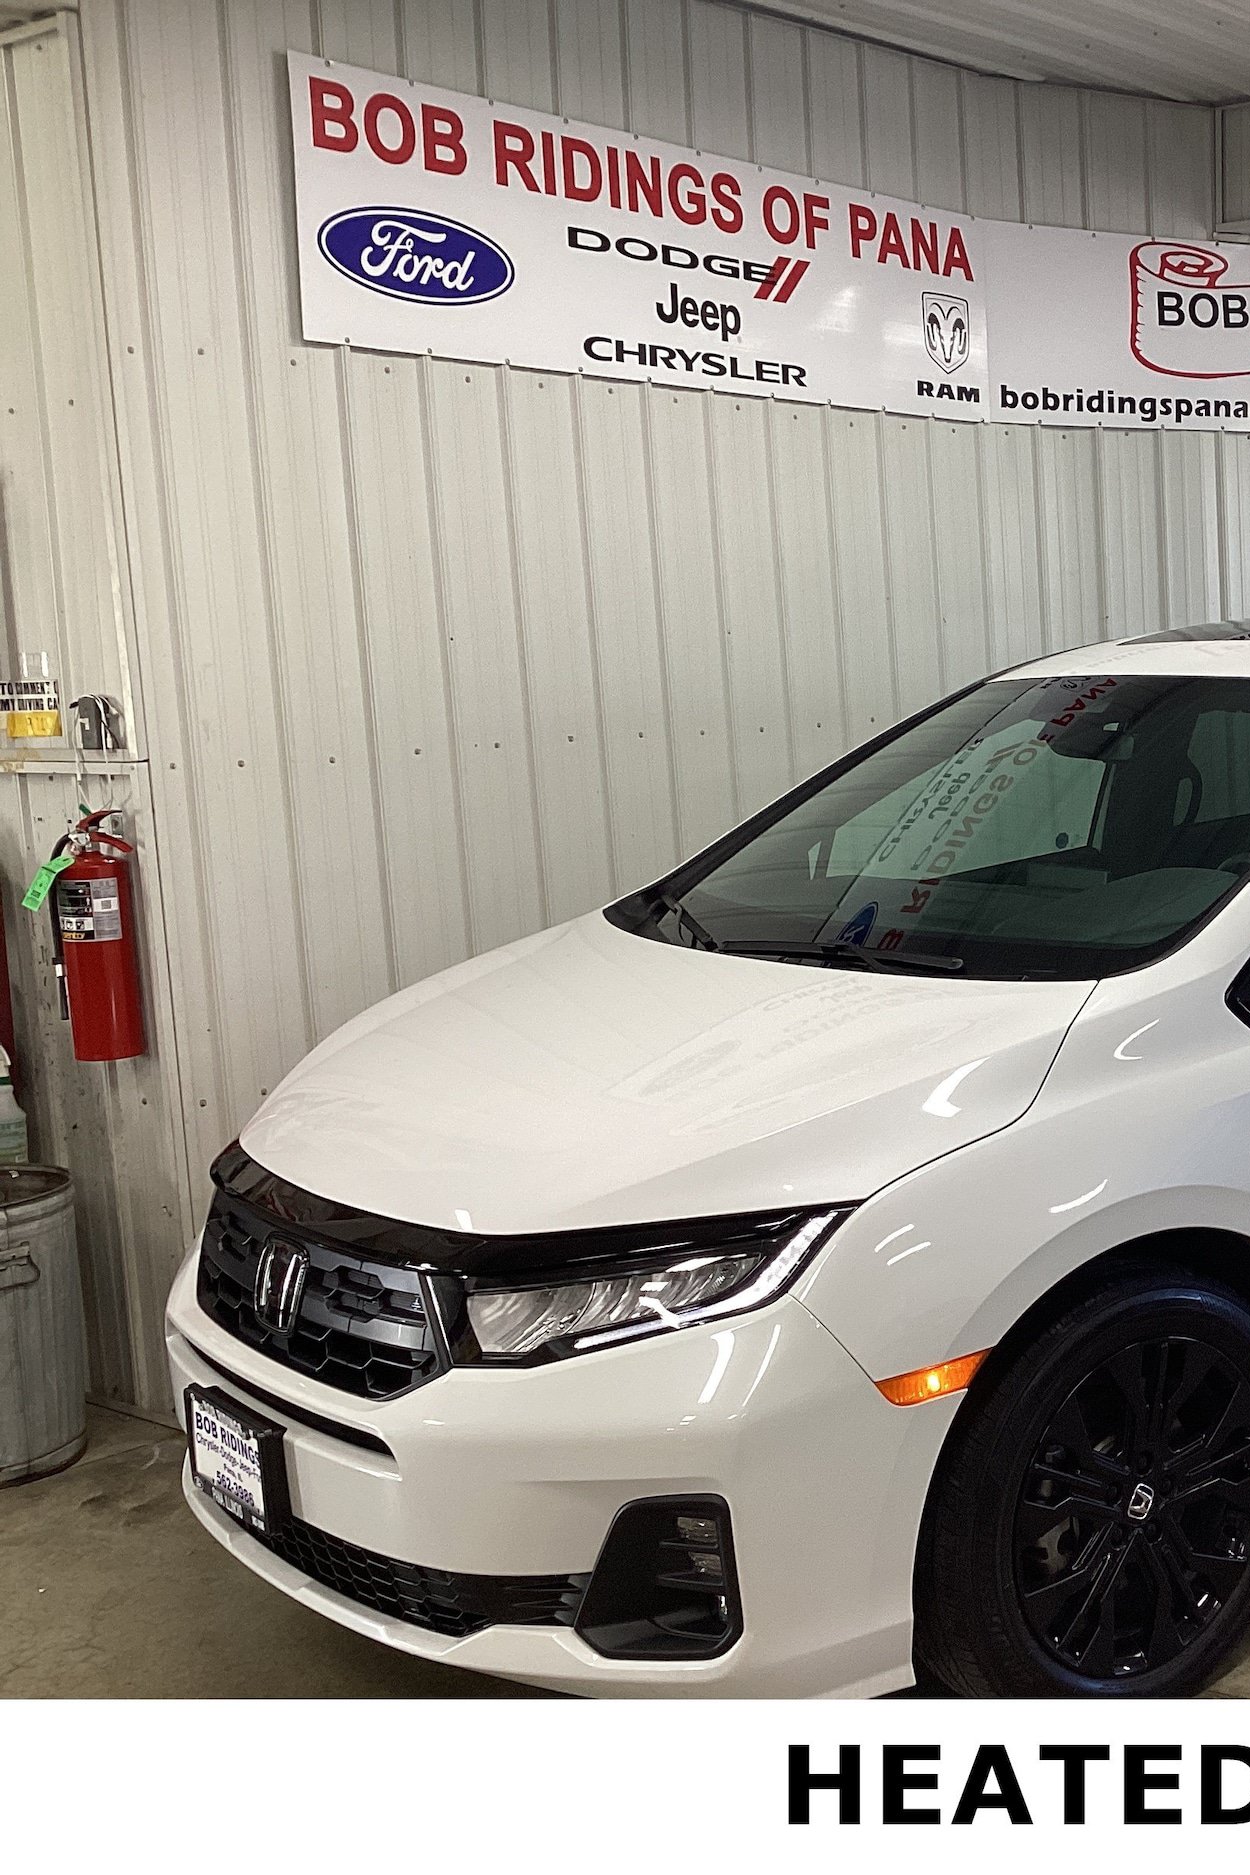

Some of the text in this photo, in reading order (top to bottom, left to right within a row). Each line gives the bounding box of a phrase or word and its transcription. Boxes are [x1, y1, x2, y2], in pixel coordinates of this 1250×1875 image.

[308, 76, 976, 281] BOB RIDINGS OF PANA
[360, 221, 476, 292] Ford
[567, 226, 778, 285] DODGE
[655, 283, 743, 342] Jeep
[1156, 290, 1249, 329] BOB
[582, 336, 809, 388] CHRYSLER
[916, 380, 981, 404] RAM
[195, 1411, 218, 1439] BOB
[220, 1426, 260, 1468] RIDINGS
